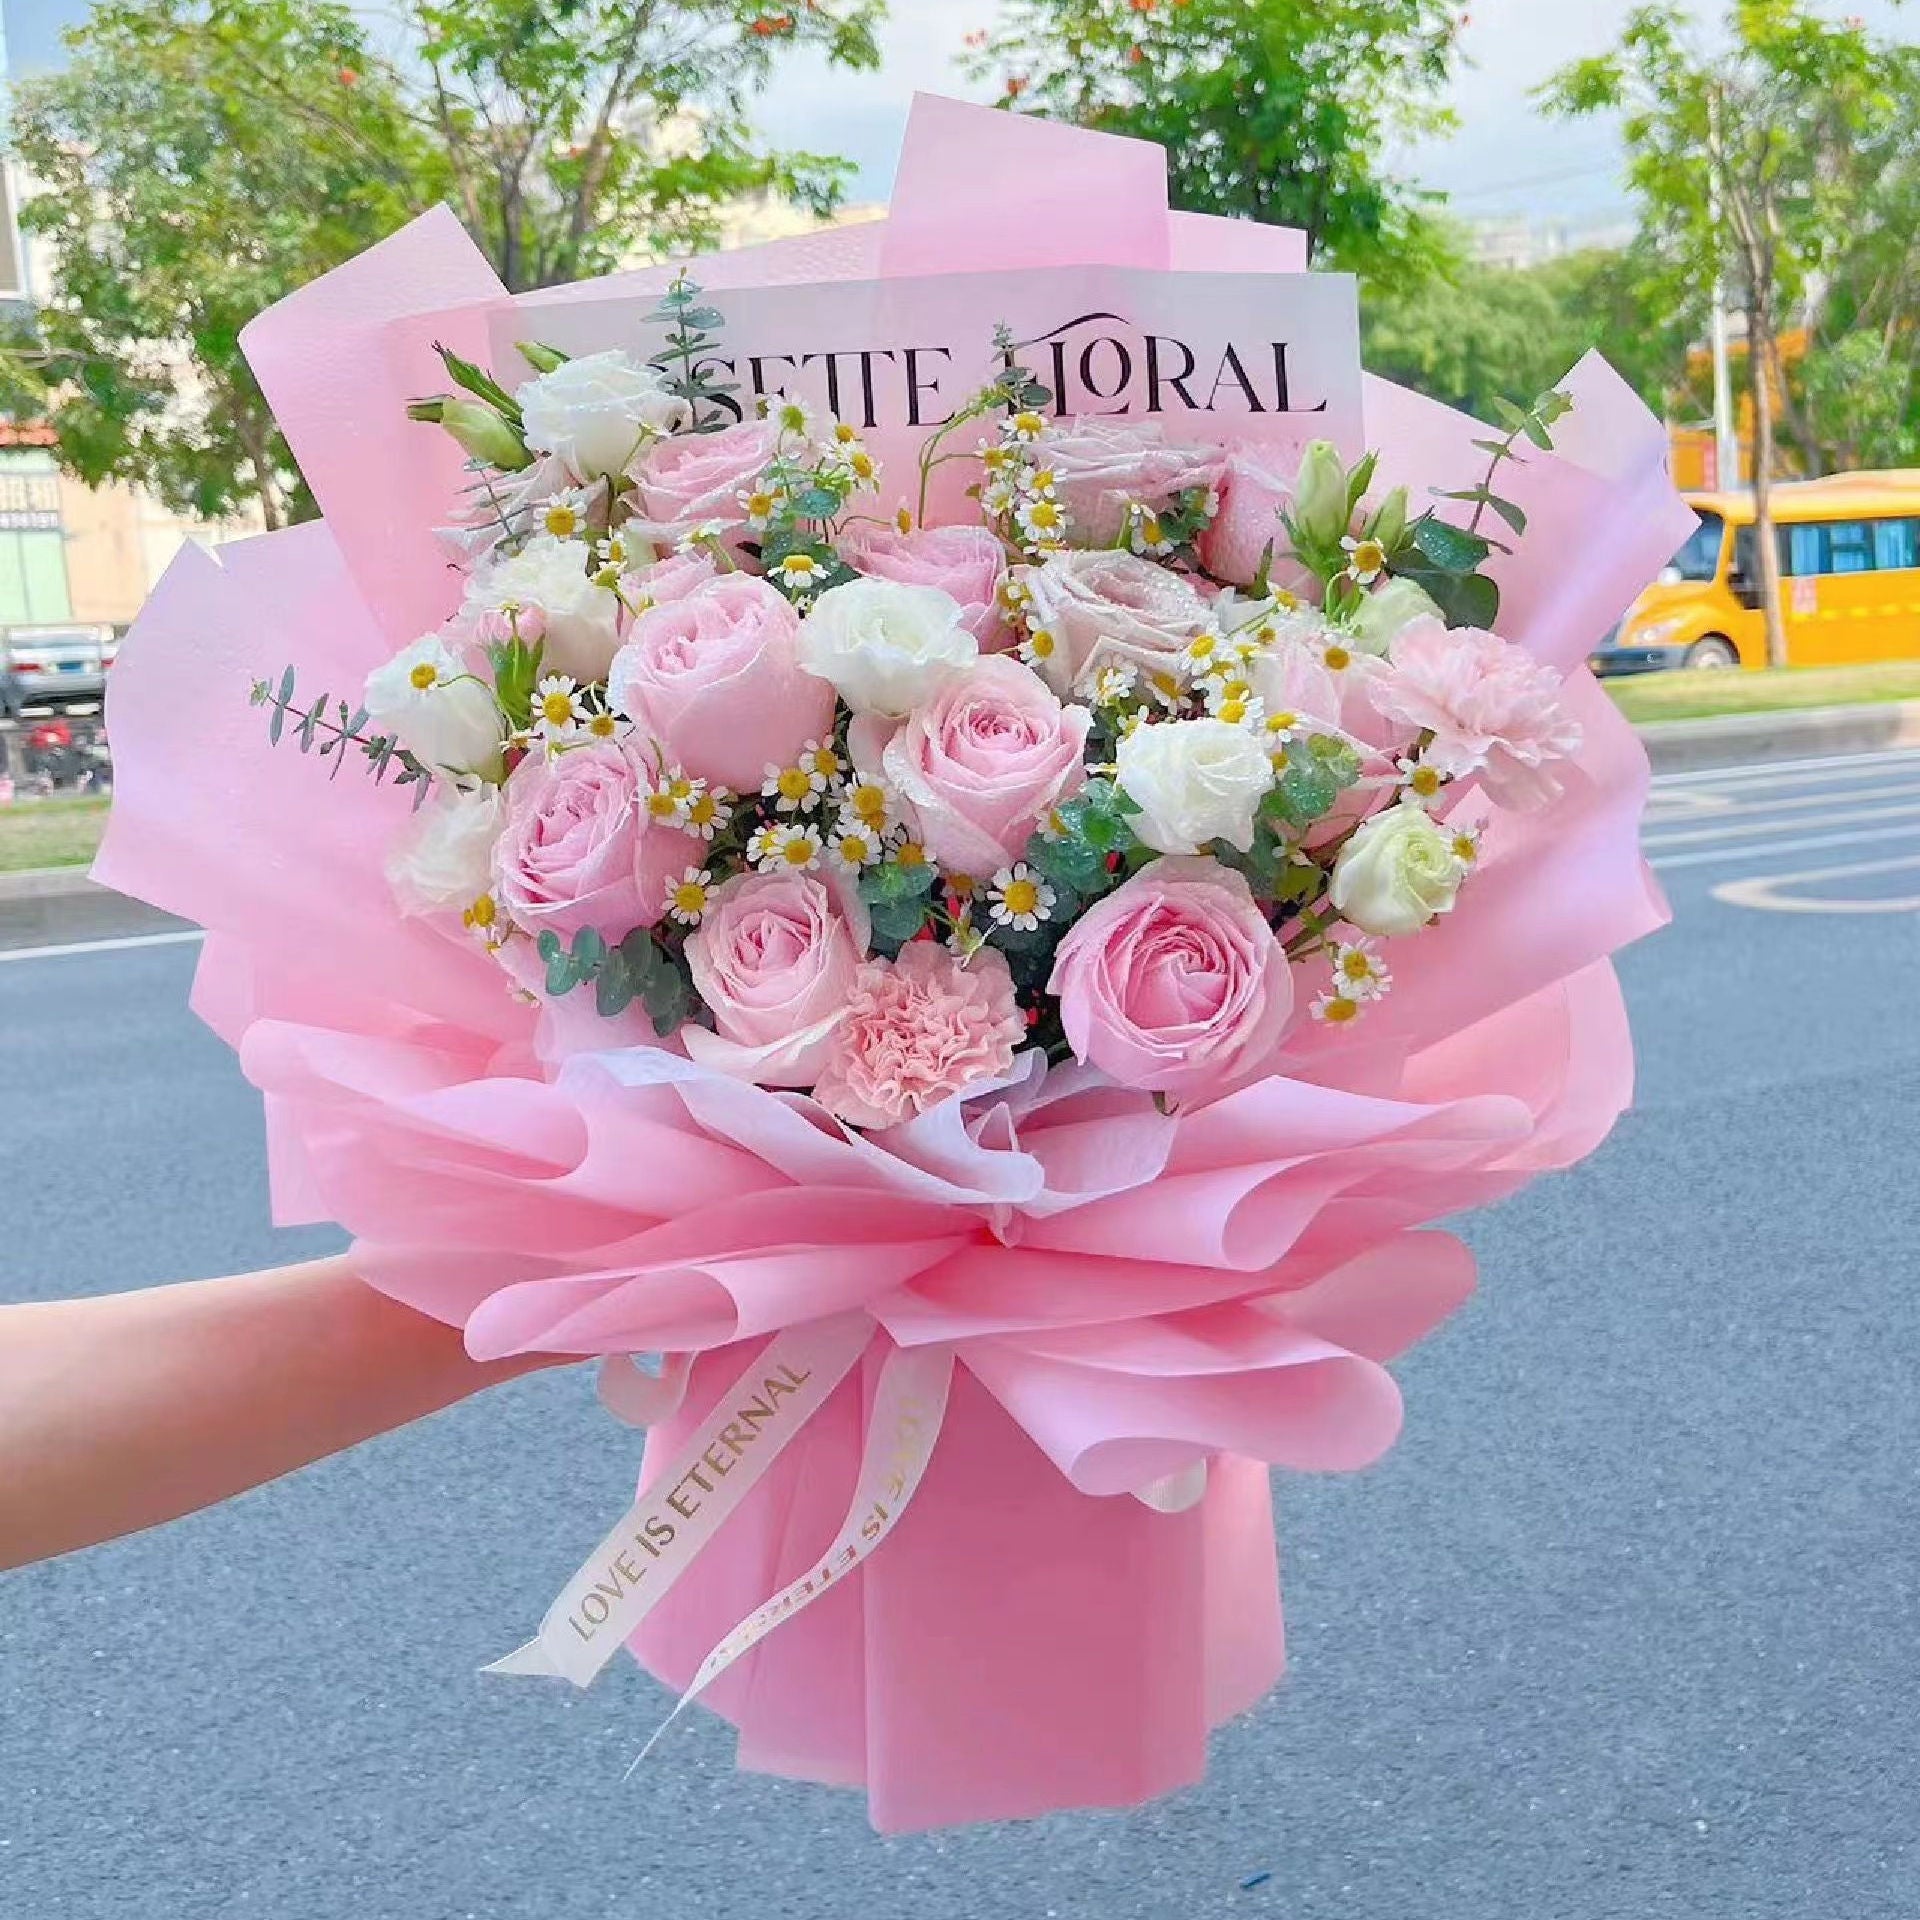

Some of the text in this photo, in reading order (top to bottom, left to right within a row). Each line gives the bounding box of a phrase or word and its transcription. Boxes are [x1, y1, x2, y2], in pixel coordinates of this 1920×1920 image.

[568, 1363, 811, 1642] LOVE IS ETERNAL
